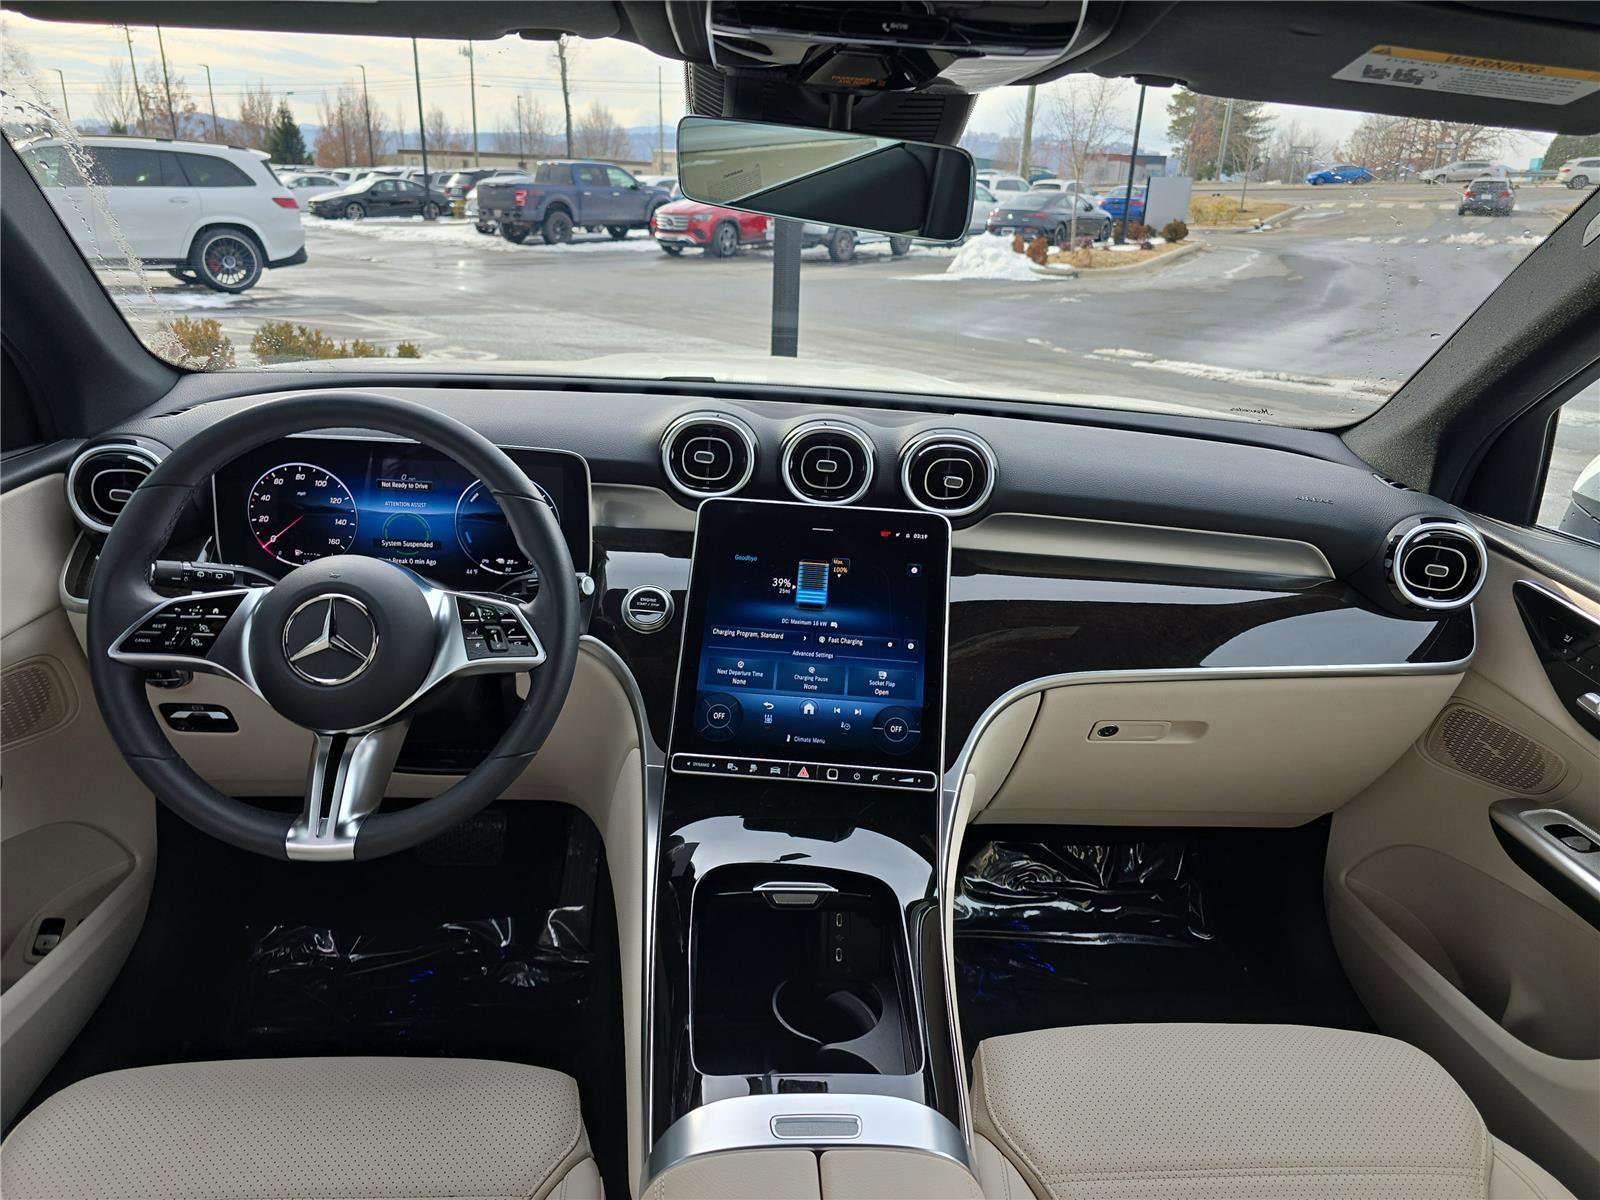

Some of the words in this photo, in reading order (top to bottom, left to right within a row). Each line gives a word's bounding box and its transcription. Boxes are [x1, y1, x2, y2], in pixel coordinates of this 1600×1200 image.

[1444, 54, 1547, 75] WARNING
[295, 473, 306, 481] 80
[414, 482, 429, 490] Drive
[384, 500, 410, 508] ATTENTION
[381, 540, 402, 548] System
[402, 540, 434, 549] Suspended
[425, 558, 437, 567] Ago
[734, 554, 758, 563] Goodbye
[833, 566, 848, 574] 100%
[772, 577, 792, 588] 39%
[712, 628, 736, 637] Charging
[736, 629, 760, 639] Program,
[760, 631, 785, 640] Standard
[828, 636, 840, 644] Fast
[840, 637, 864, 647] Charging
[792, 650, 815, 658] Advanced
[815, 651, 834, 660] Settings
[728, 669, 752, 677] Departure
[752, 670, 764, 678] Time
[732, 678, 747, 686] None
[793, 674, 815, 682] Charging
[803, 683, 818, 691] None
[874, 688, 890, 696] Open
[713, 712, 726, 720] OFF
[890, 725, 903, 733] OFF
[793, 735, 812, 743] Climate
[812, 736, 826, 744] Menu
